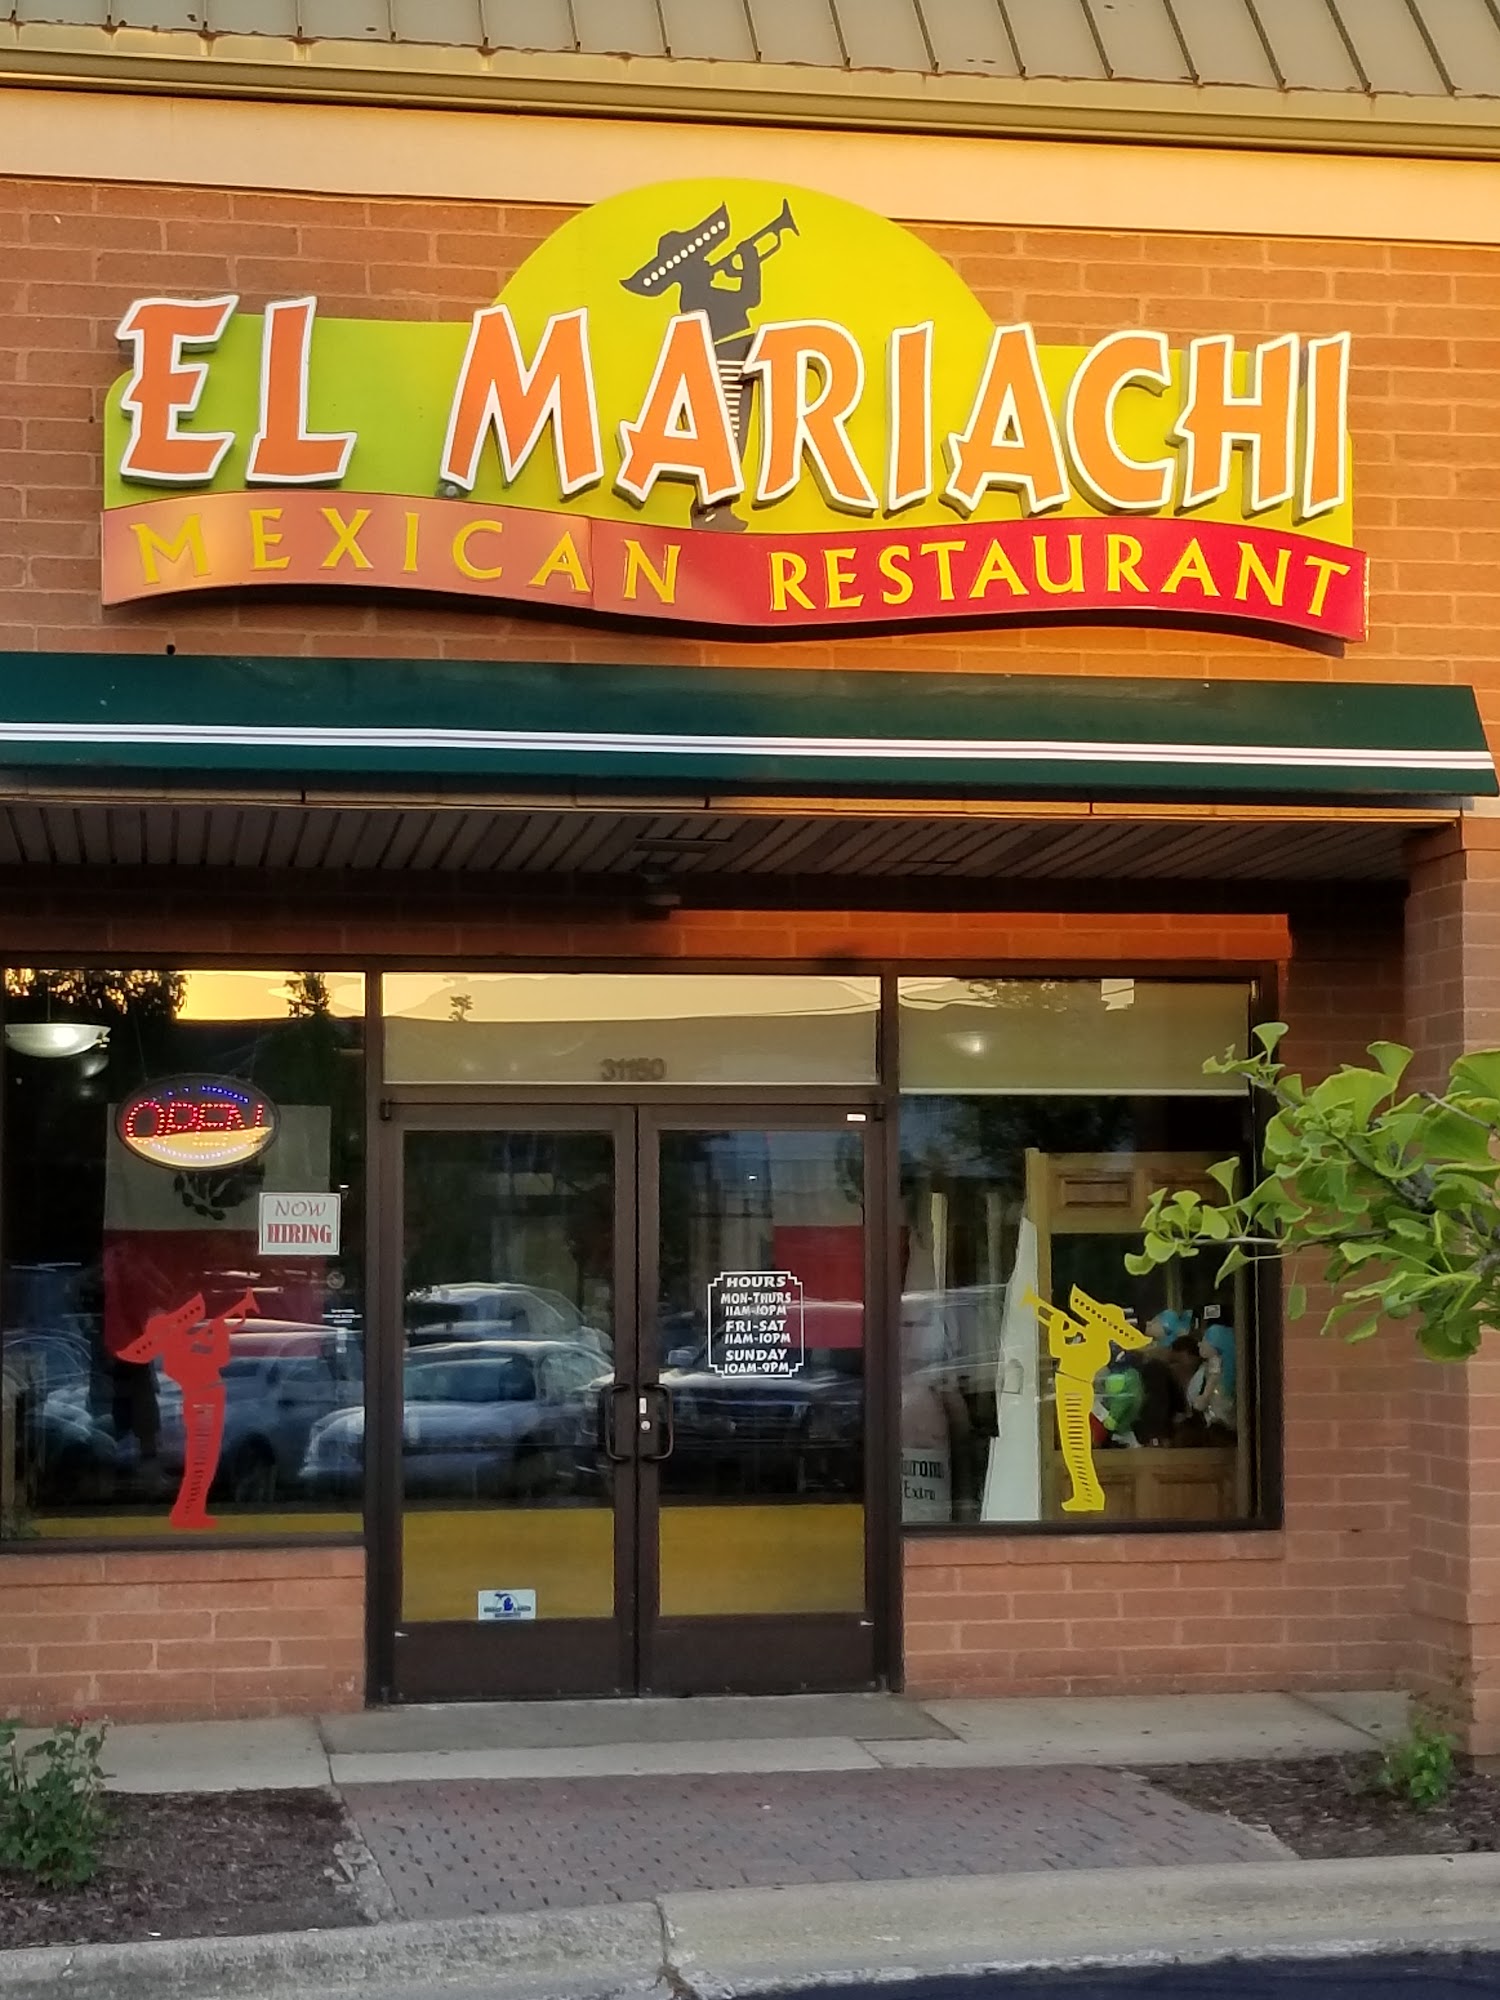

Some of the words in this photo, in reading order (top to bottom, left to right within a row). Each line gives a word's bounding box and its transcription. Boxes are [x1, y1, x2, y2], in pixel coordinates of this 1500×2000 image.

[114, 295, 358, 483] EL
[440, 304, 1351, 518] MARIACHI
[130, 507, 681, 605] MEXICAN
[769, 533, 1351, 617] RESTAURANT
[125, 1101, 265, 1148] OPEN
[275, 1200, 326, 1216] NOW
[267, 1223, 332, 1244] HIRING
[726, 1276, 786, 1288] HOURS
[721, 1292, 792, 1304] MON-THURS
[725, 1304, 787, 1317] 11AM-10PM
[725, 1320, 787, 1333] FRI-SAT
[725, 1333, 791, 1345] 11AM-10PM
[725, 1349, 787, 1362] SUNDAY
[724, 1363, 789, 1374] 10AM-9PM
